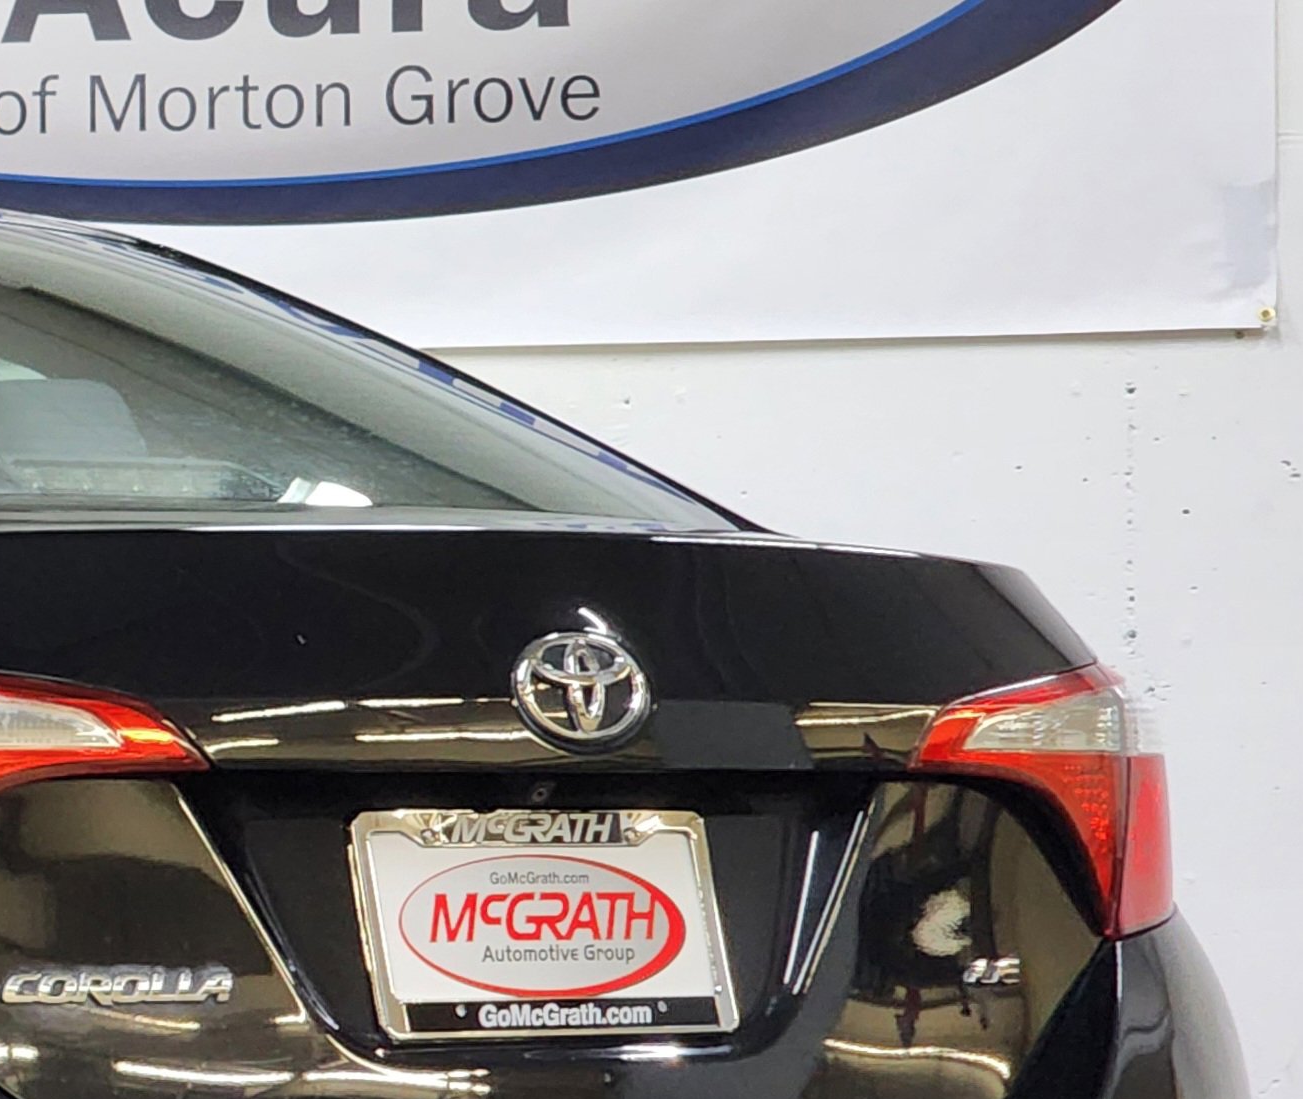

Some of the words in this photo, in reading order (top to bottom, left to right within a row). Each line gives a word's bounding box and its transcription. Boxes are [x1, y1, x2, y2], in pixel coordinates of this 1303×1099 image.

[87, 73, 354, 133] Morton
[385, 64, 602, 126] Grove
[489, 870, 590, 886] GoMcGrath.com
[481, 944, 580, 964] Automotive
[583, 943, 636, 966] Group
[1, 966, 234, 1007] COROLLA
[478, 1001, 653, 1028] GoMcGrath.com
